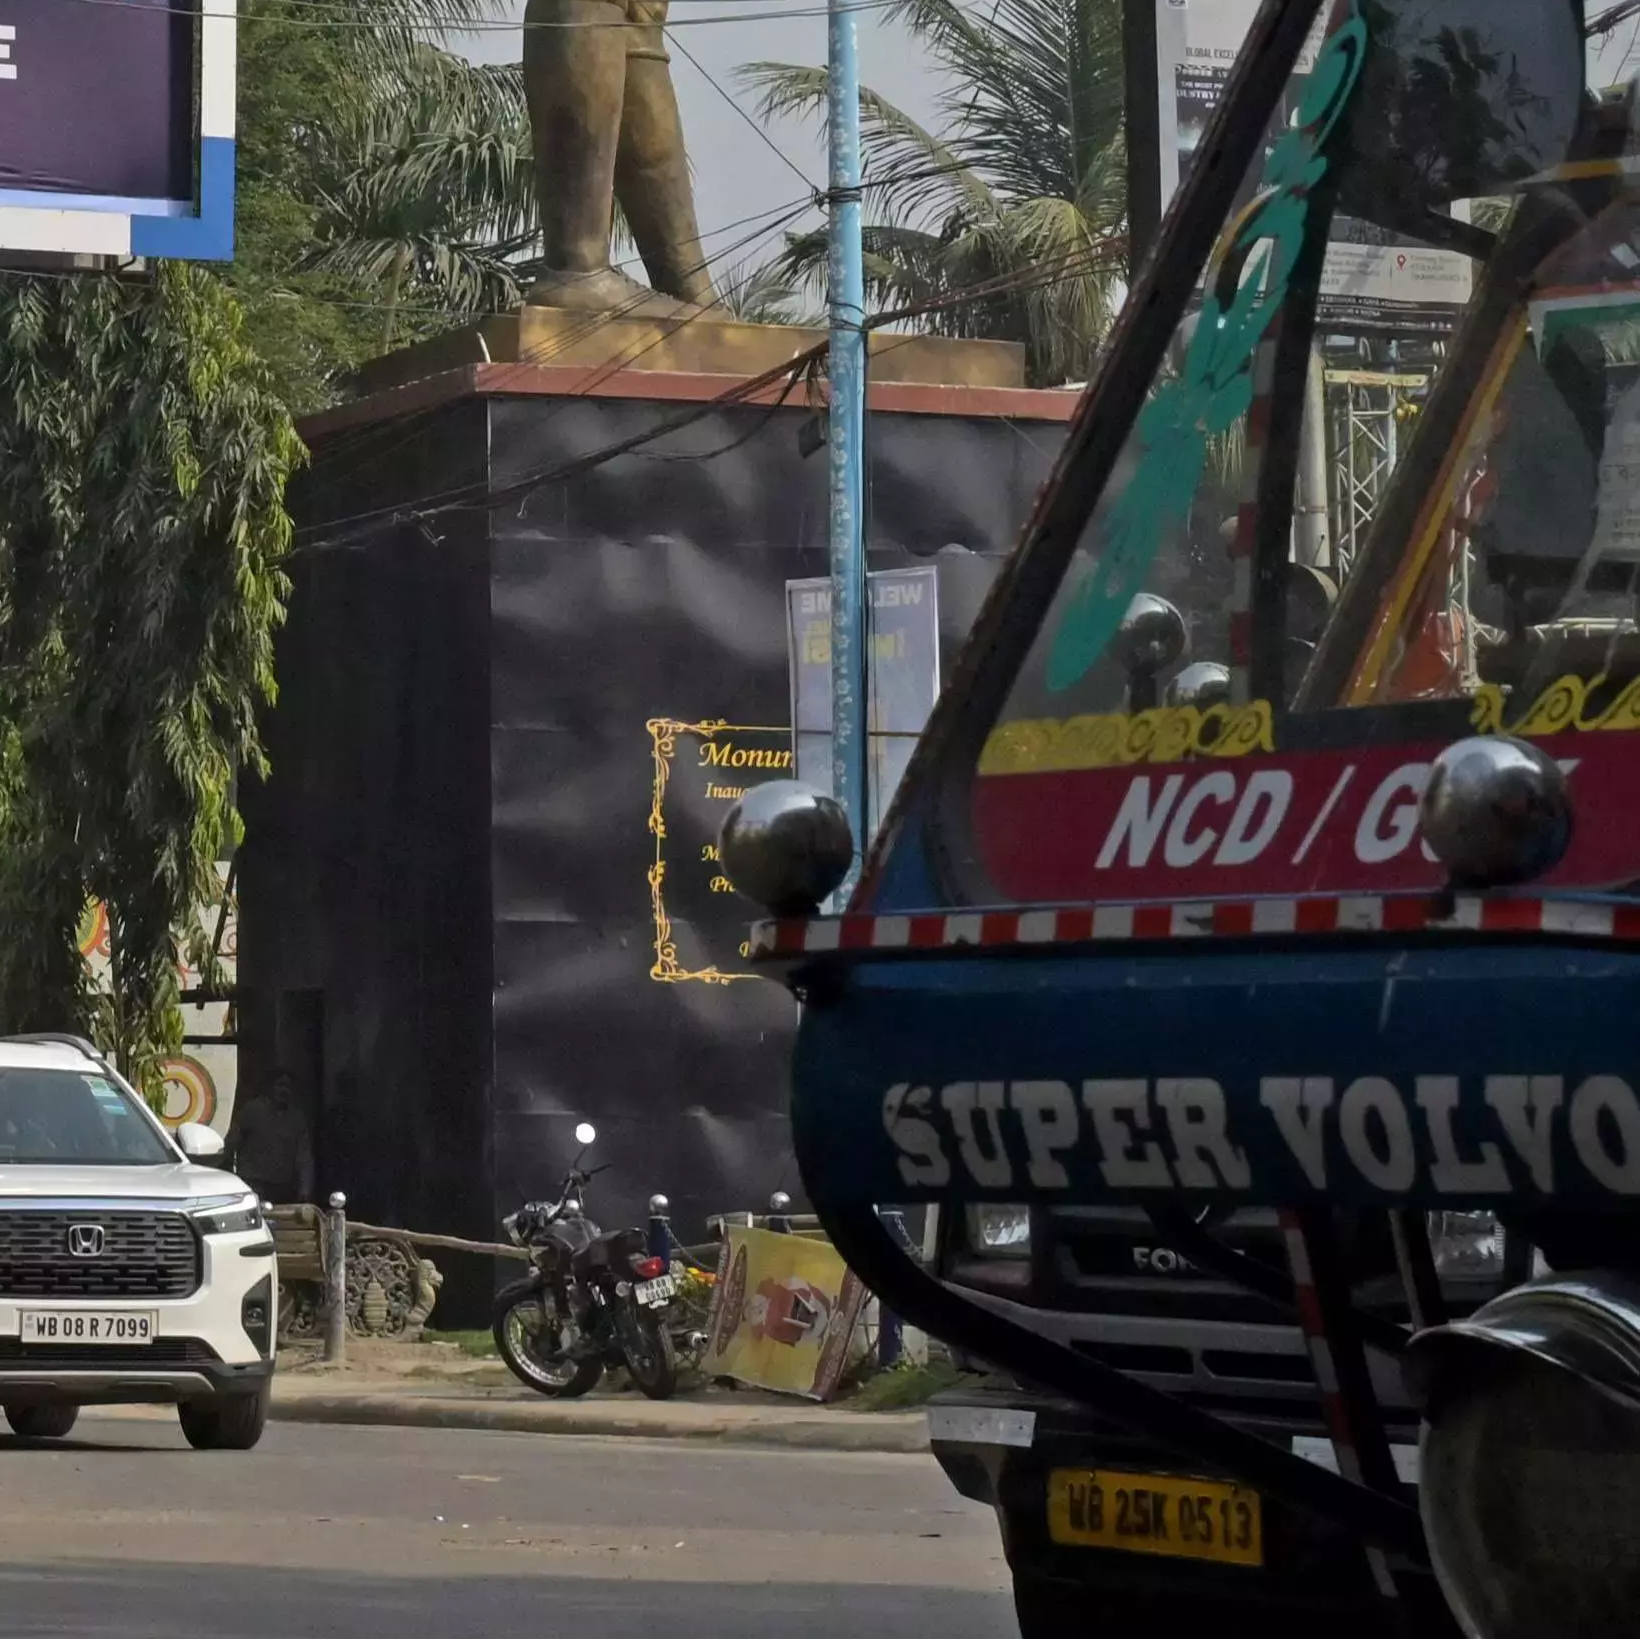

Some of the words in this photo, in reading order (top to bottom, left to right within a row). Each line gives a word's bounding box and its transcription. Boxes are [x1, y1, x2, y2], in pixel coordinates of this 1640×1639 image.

[1096, 765, 1296, 870] NCD
[881, 1076, 1253, 1196] SUPER
[1259, 1074, 1640, 1196] VOLVO
[36, 1316, 58, 1337] WB
[63, 1317, 84, 1337] 08
[89, 1317, 100, 1338] R
[105, 1317, 149, 1338] 7099
